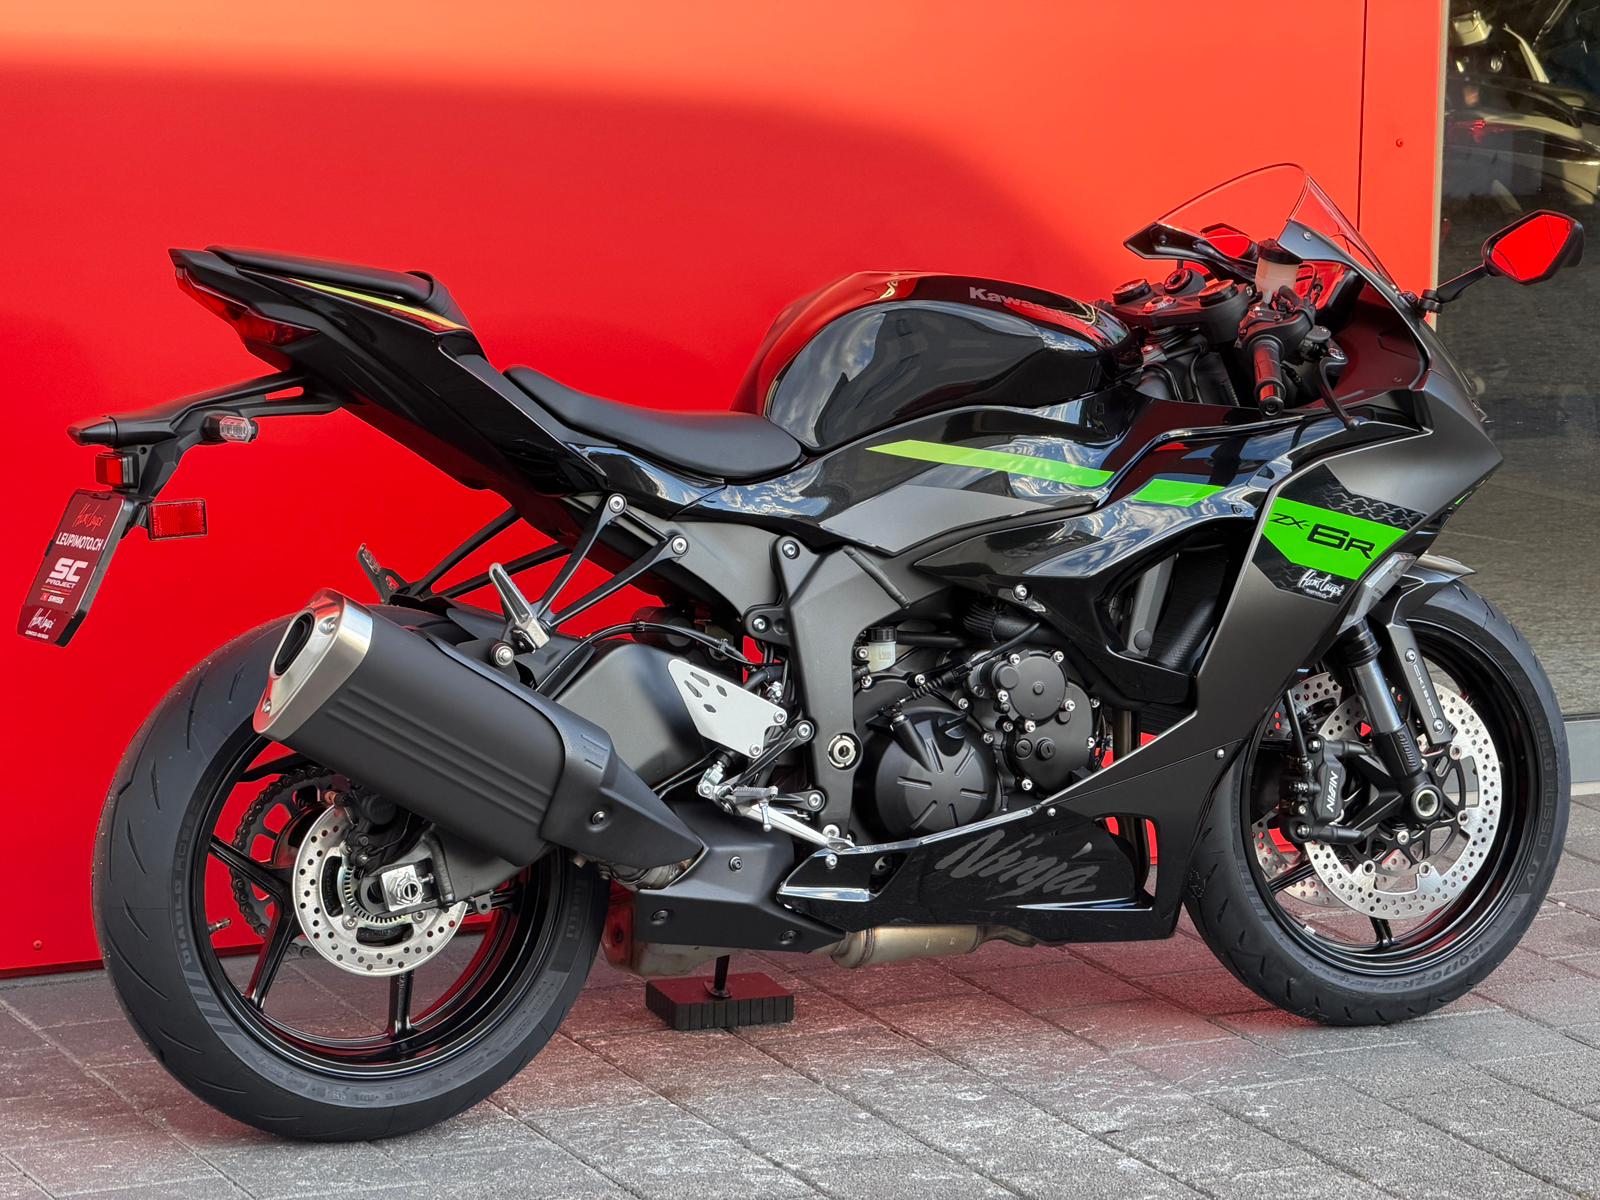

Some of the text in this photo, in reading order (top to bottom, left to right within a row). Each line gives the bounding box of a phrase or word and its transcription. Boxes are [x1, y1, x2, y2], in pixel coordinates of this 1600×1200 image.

[55, 532, 104, 551] LEUPIMOTO.CH
[45, 578, 76, 589] PROJECT
[49, 557, 89, 583] SC
[1326, 770, 1340, 813] NISSIN
[934, 829, 1100, 900] Ninja
[174, 879, 193, 967] DIABLO
